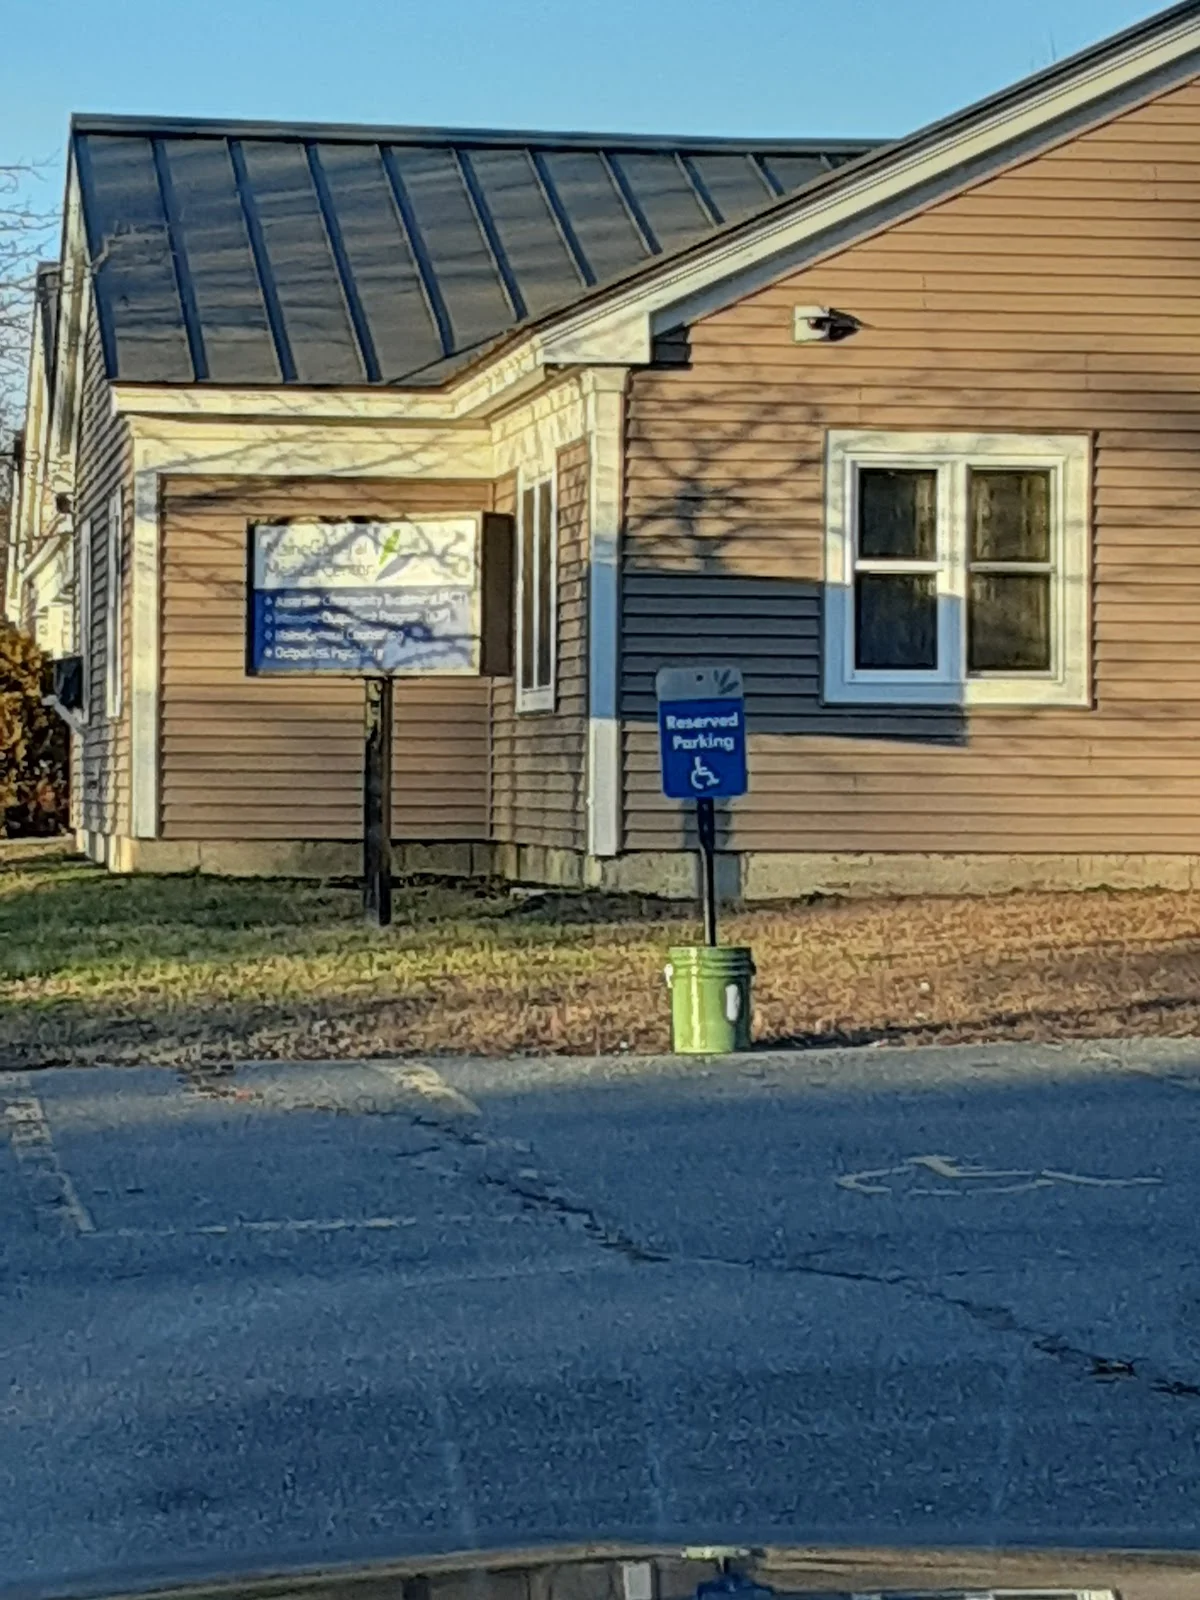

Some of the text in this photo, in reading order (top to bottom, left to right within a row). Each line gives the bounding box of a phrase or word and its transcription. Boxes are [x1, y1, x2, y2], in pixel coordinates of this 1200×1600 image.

[265, 538, 368, 556] MaineGeal
[666, 711, 738, 730] Reserved
[672, 732, 735, 751] Parking
